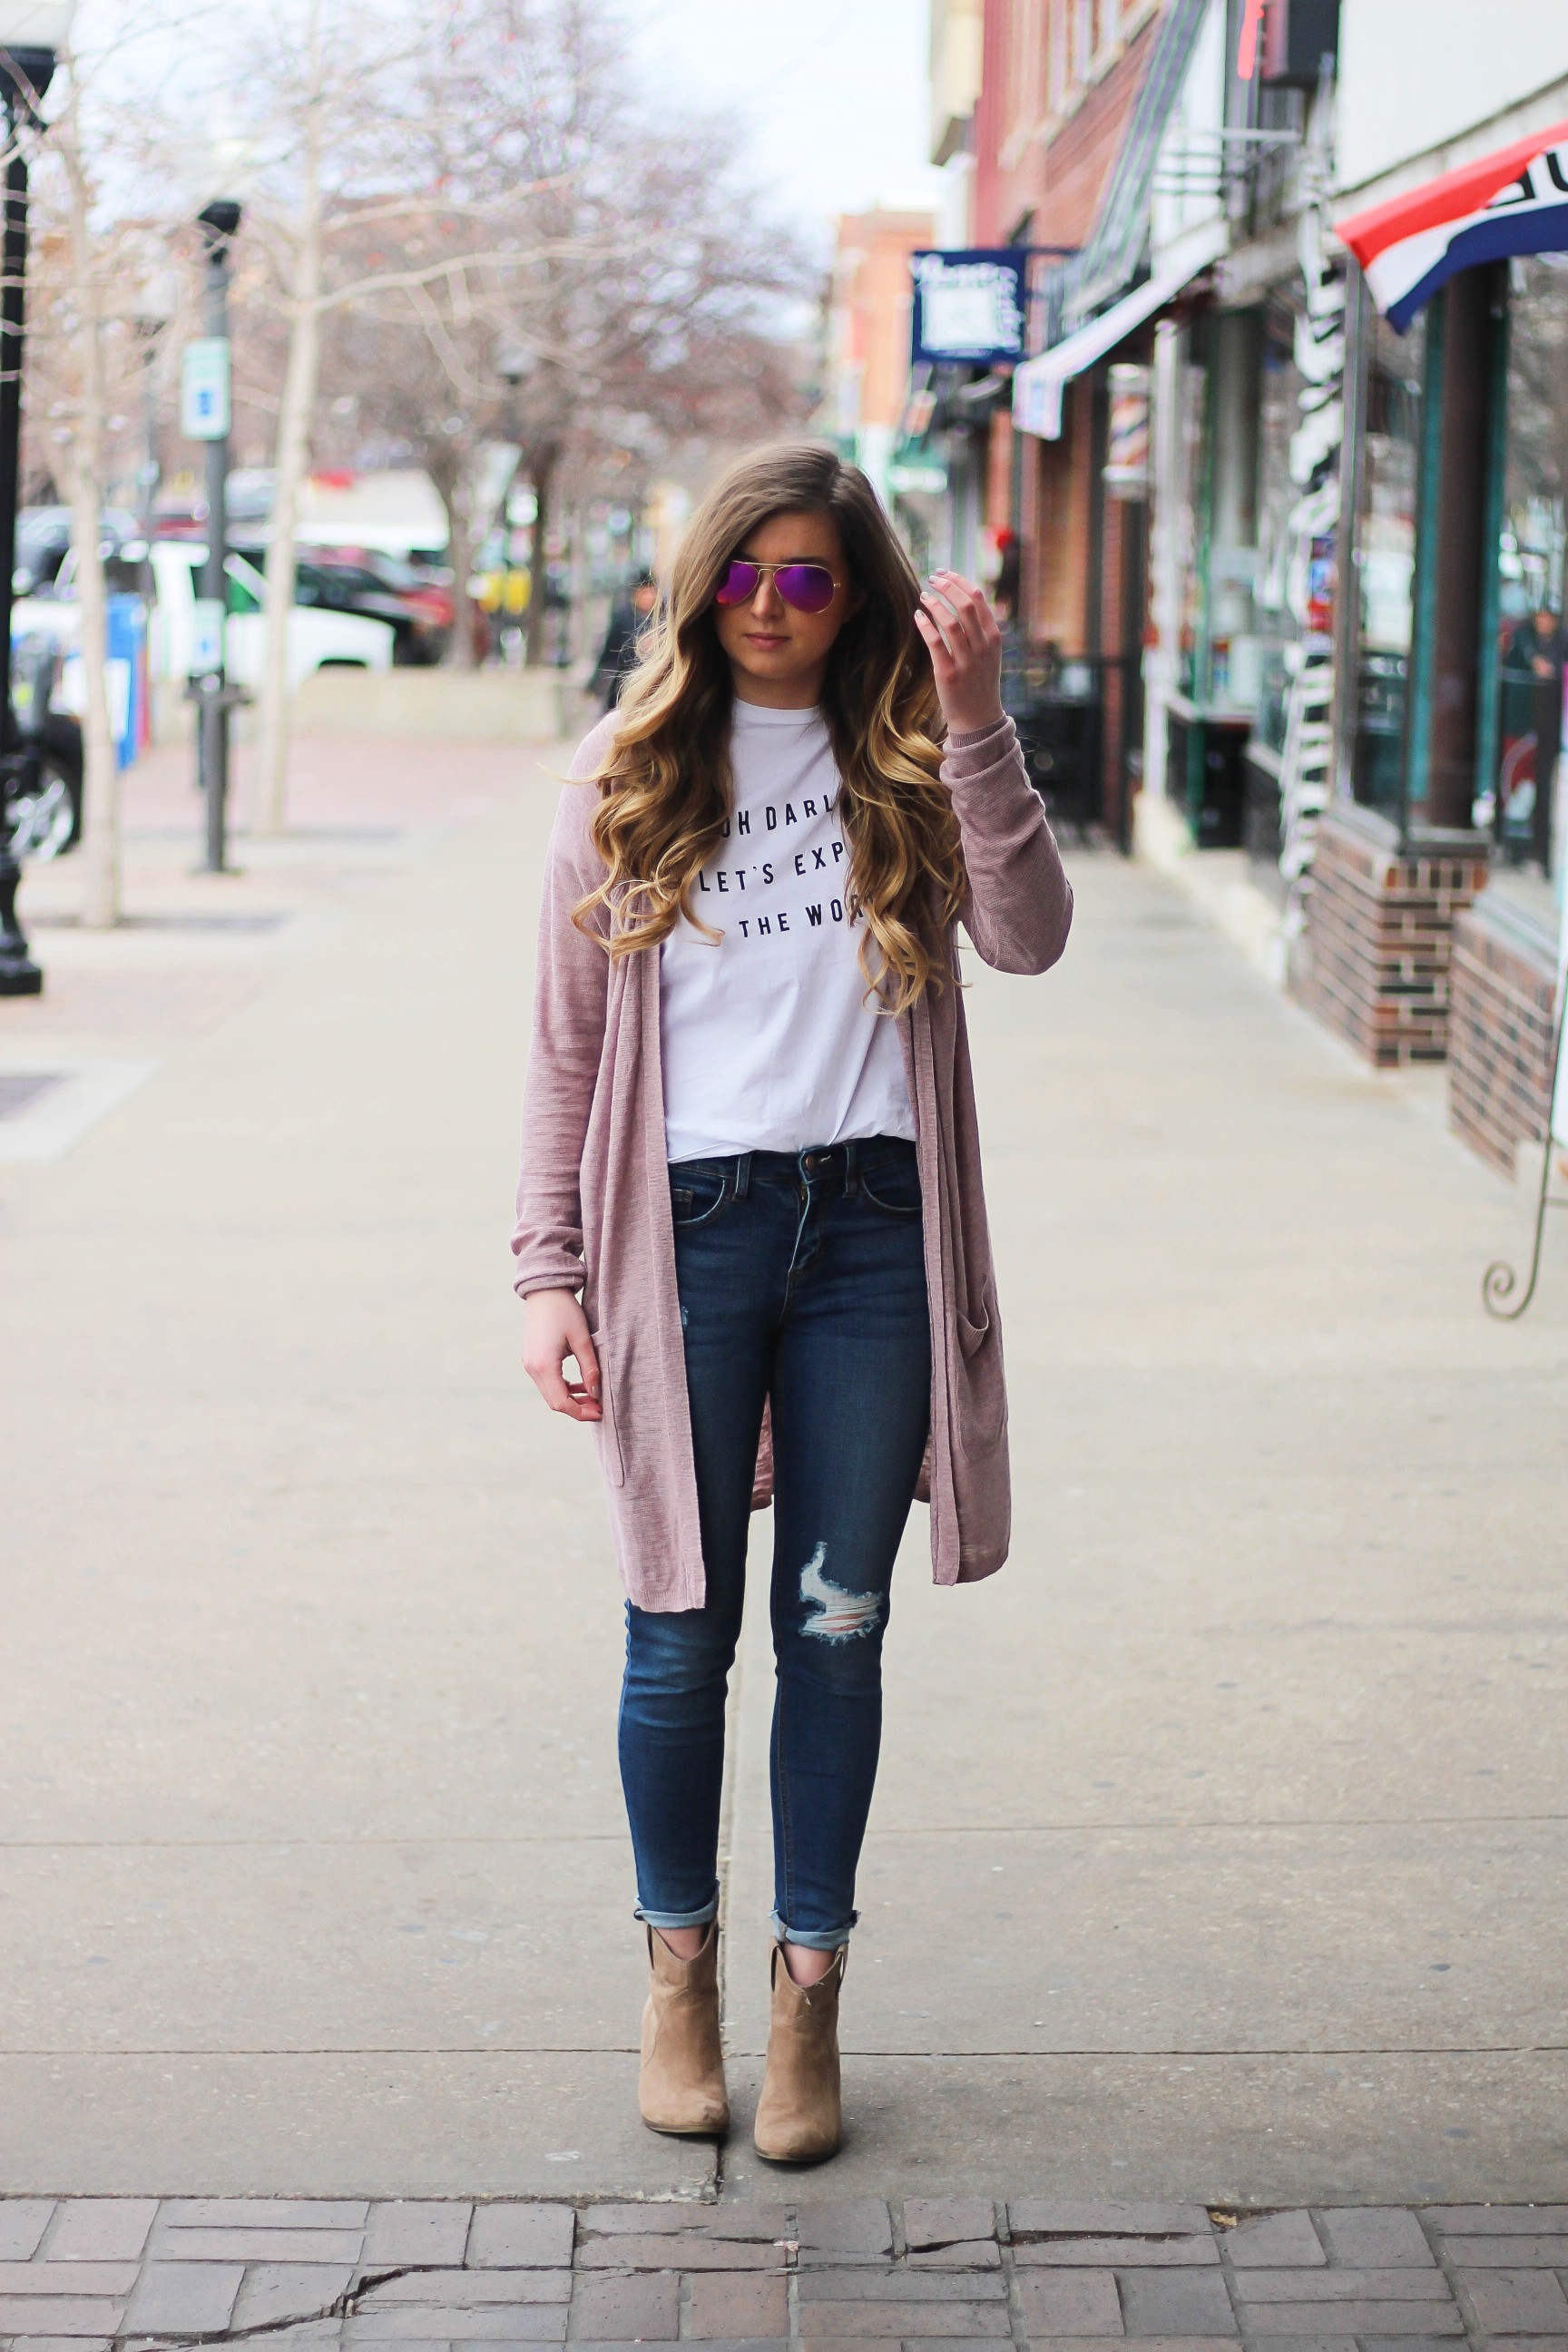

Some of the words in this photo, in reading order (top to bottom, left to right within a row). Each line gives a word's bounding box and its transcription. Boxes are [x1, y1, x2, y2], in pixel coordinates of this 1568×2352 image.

[766, 795, 833, 831] DARL
[699, 863, 774, 893] LET'S
[794, 842, 844, 877] EXP
[739, 913, 790, 938] THE
